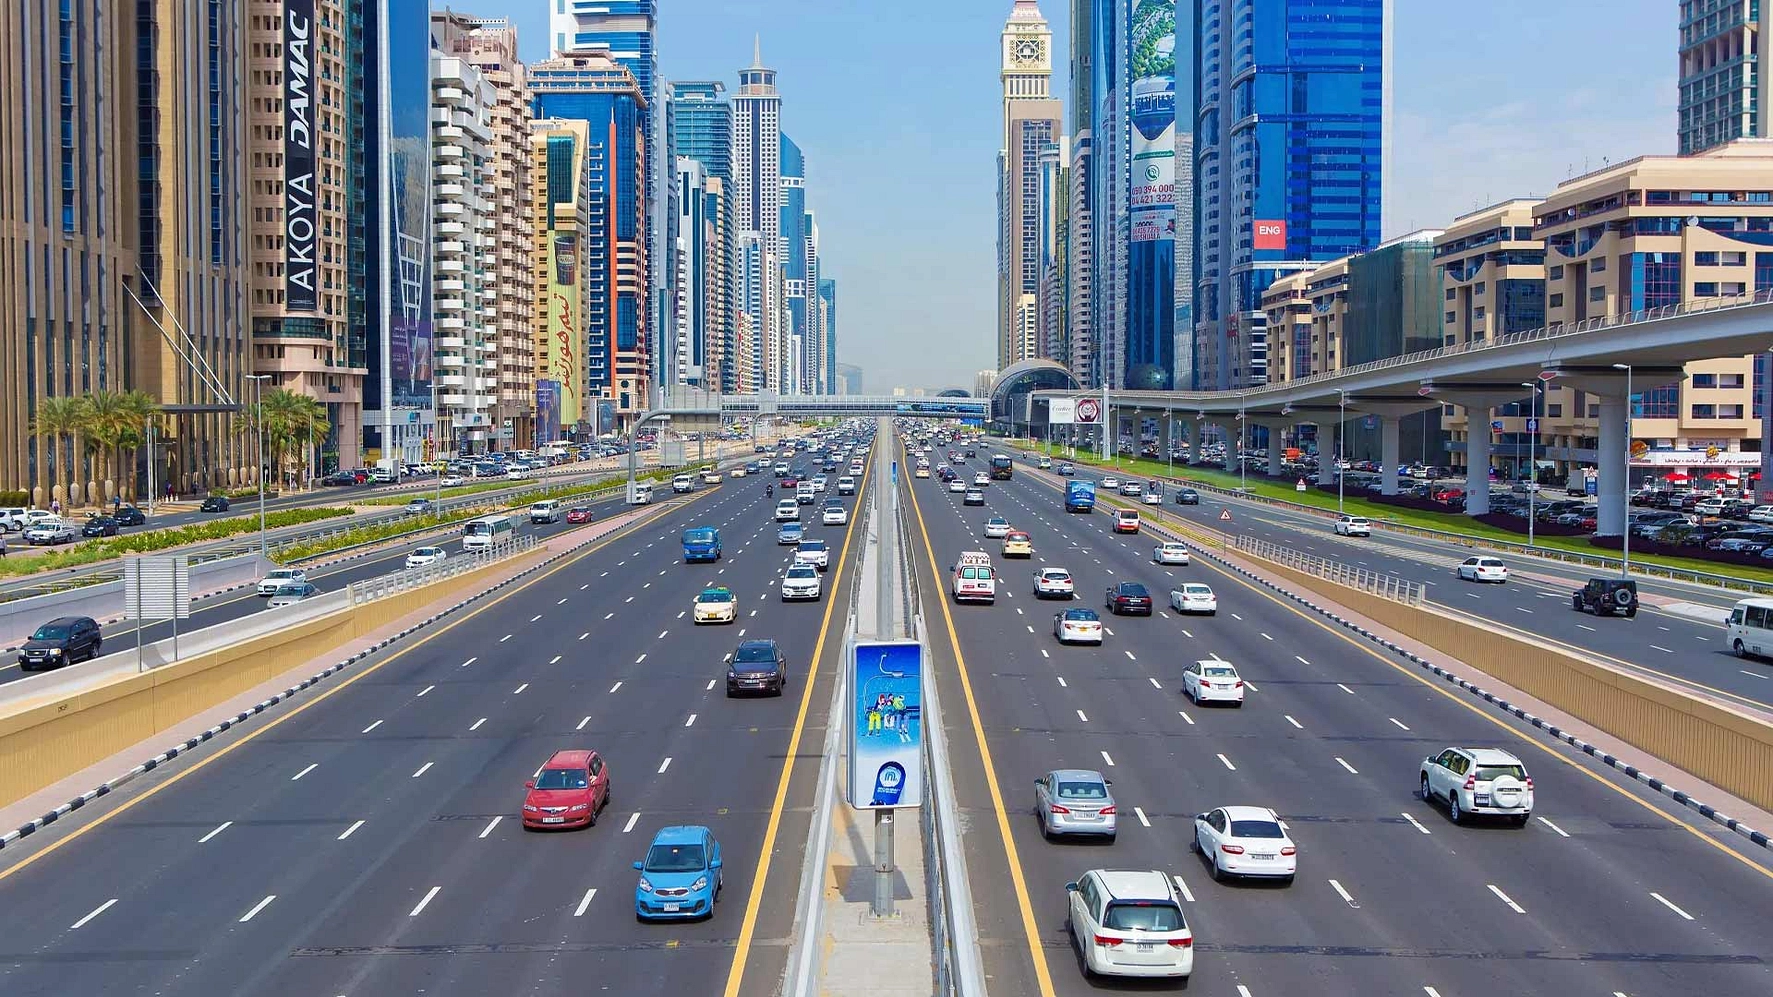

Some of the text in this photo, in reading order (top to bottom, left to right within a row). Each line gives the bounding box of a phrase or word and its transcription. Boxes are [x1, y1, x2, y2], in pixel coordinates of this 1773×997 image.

[289, 10, 310, 150] DAMAC
[1143, 185, 1157, 194] 394
[1140, 194, 1154, 205] 421
[289, 172, 314, 292] AKOYA
[1259, 225, 1281, 235] ENG
